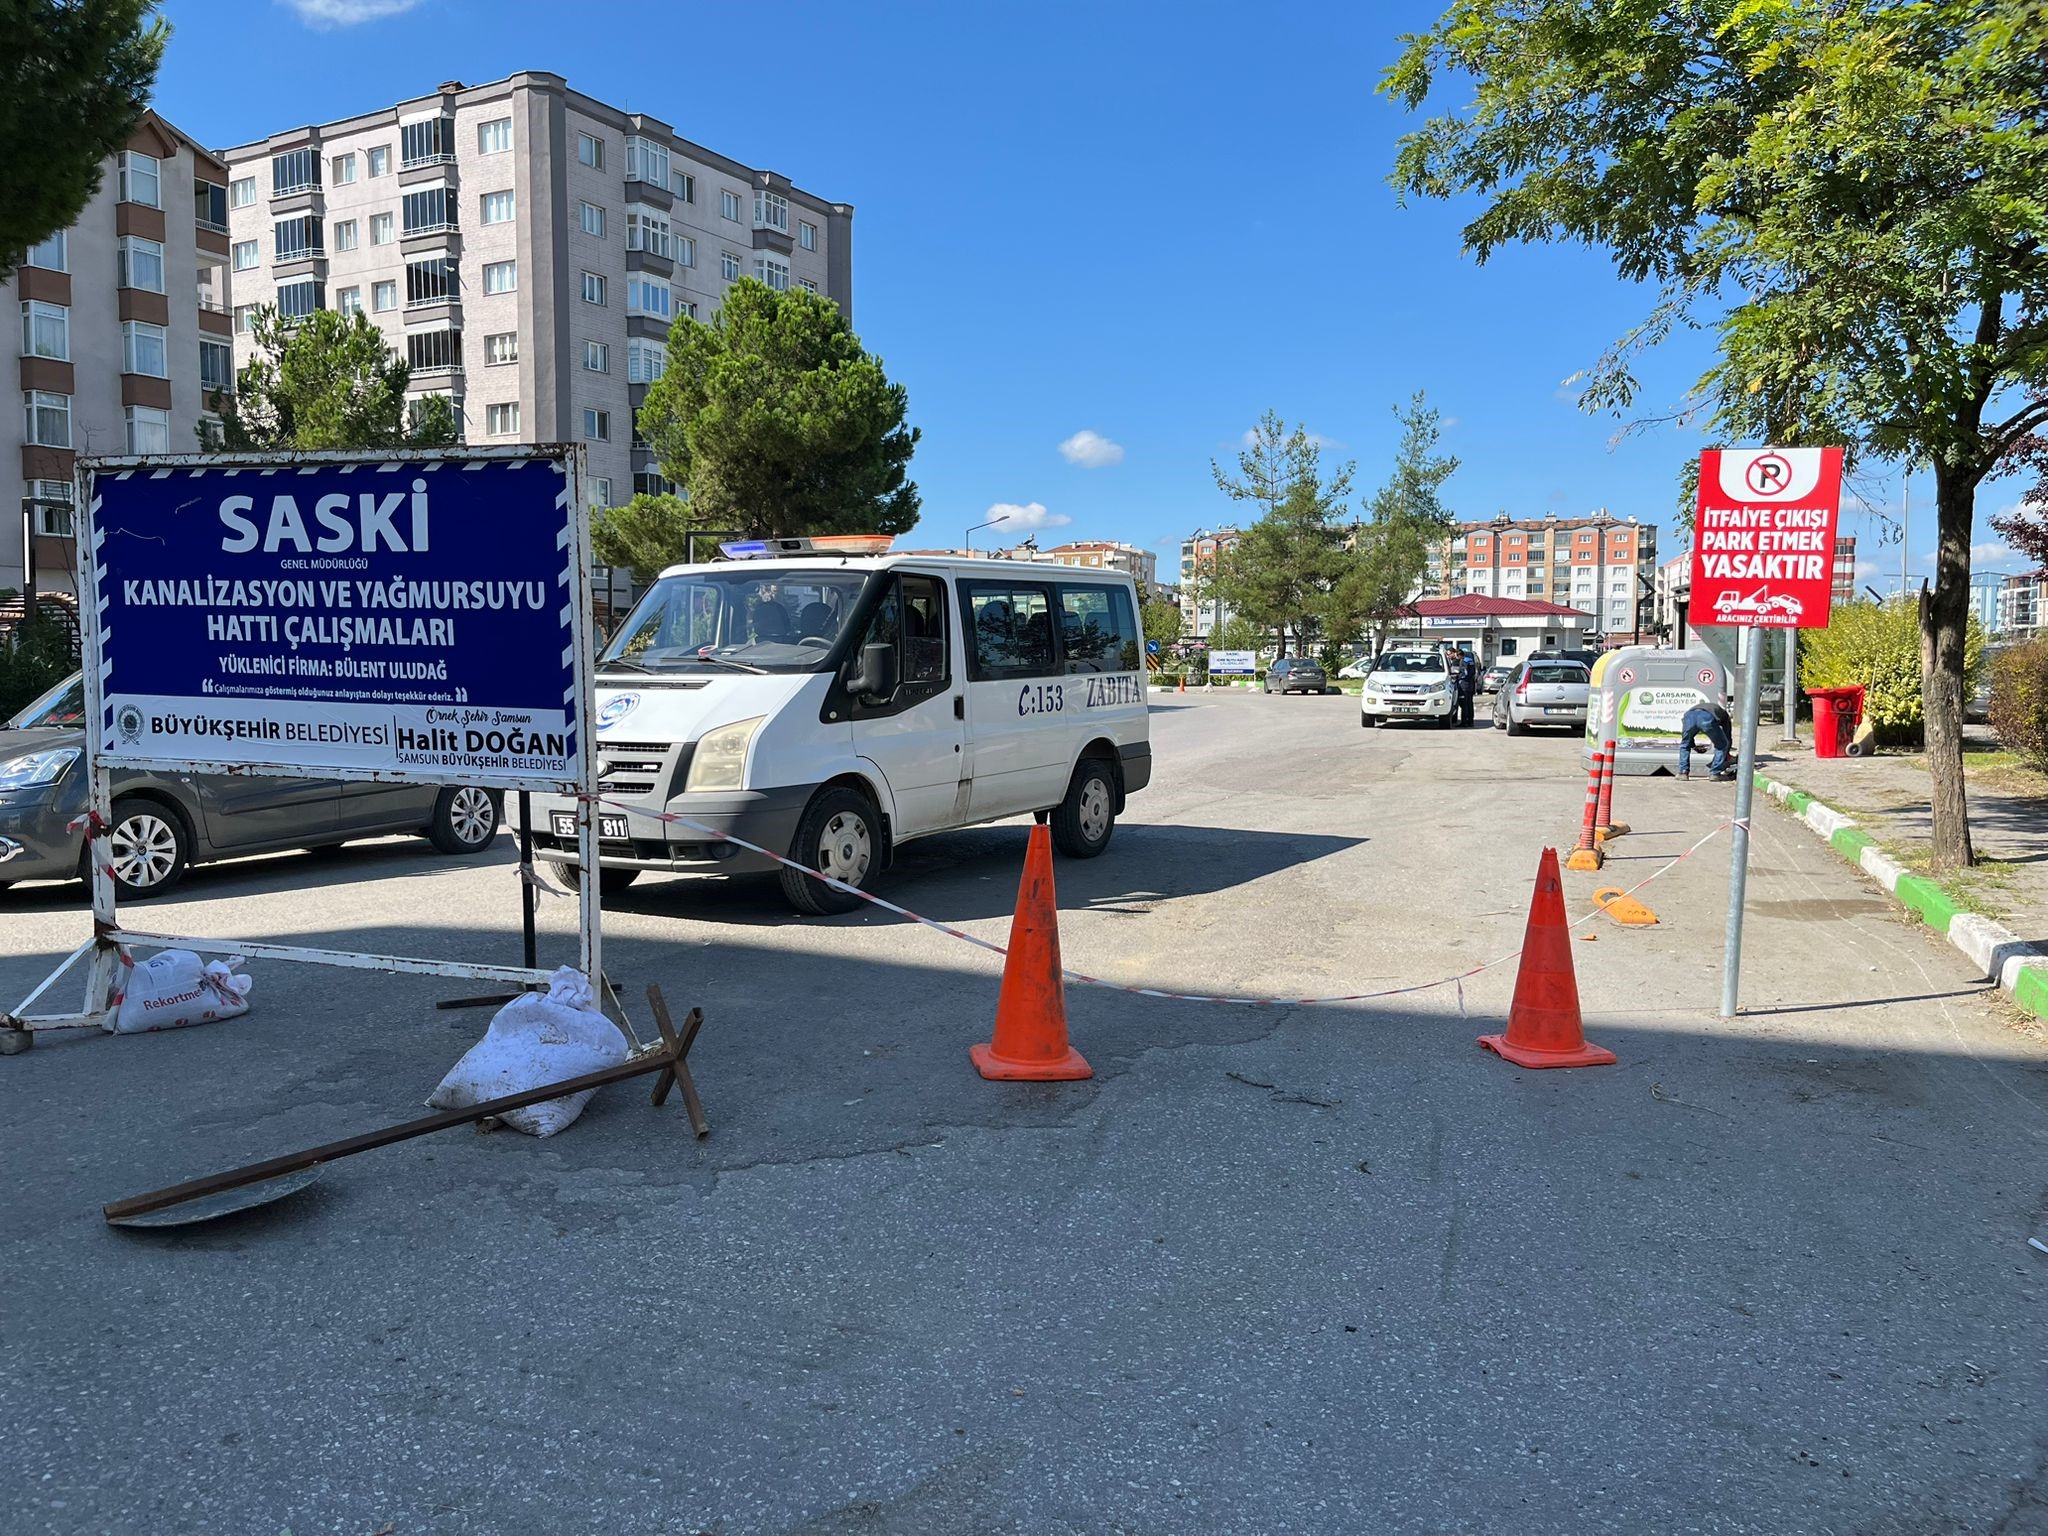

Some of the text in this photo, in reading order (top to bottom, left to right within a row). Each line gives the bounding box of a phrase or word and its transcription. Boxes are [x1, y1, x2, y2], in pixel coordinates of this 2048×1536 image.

[219, 478, 428, 553] SASKİ
[1703, 506, 1828, 530] İTFAİYE ÇIKIŞI
[1702, 531, 1825, 551] PARK ETMEK
[281, 558, 368, 569] GENEL MÜDÜRLÜĞÜ
[1701, 554, 1824, 579] YASAKTIR
[124, 574, 545, 610] KANALİZASYON VE YAĞMURSUYU
[1716, 614, 1797, 624] ARACINIZ ÇEKTİRİLİR
[207, 615, 455, 651] HATTI ÇALIŞMALARI
[219, 653, 447, 680] YÜKLENİCİ FİRMA: BÜLENT ULUDAĞ
[265, 686, 297, 697] göstermiş
[298, 688, 334, 698] olduğunuz
[335, 688, 371, 700] anlayıştan
[372, 689, 394, 701] dolayı
[395, 691, 426, 702] teşekkür
[1086, 675, 1141, 708] ZABITA
[426, 706, 532, 728] Örnek Şehir Samsun
[151, 714, 389, 745] BÜYÜKŞEHİR BELEDİYESİ
[398, 727, 565, 756] Halit DOĞAN
[399, 753, 567, 771] SAMSUN BÜYÜKŞEHİR BELEDİYESİ
[559, 818, 625, 836] 55 811
